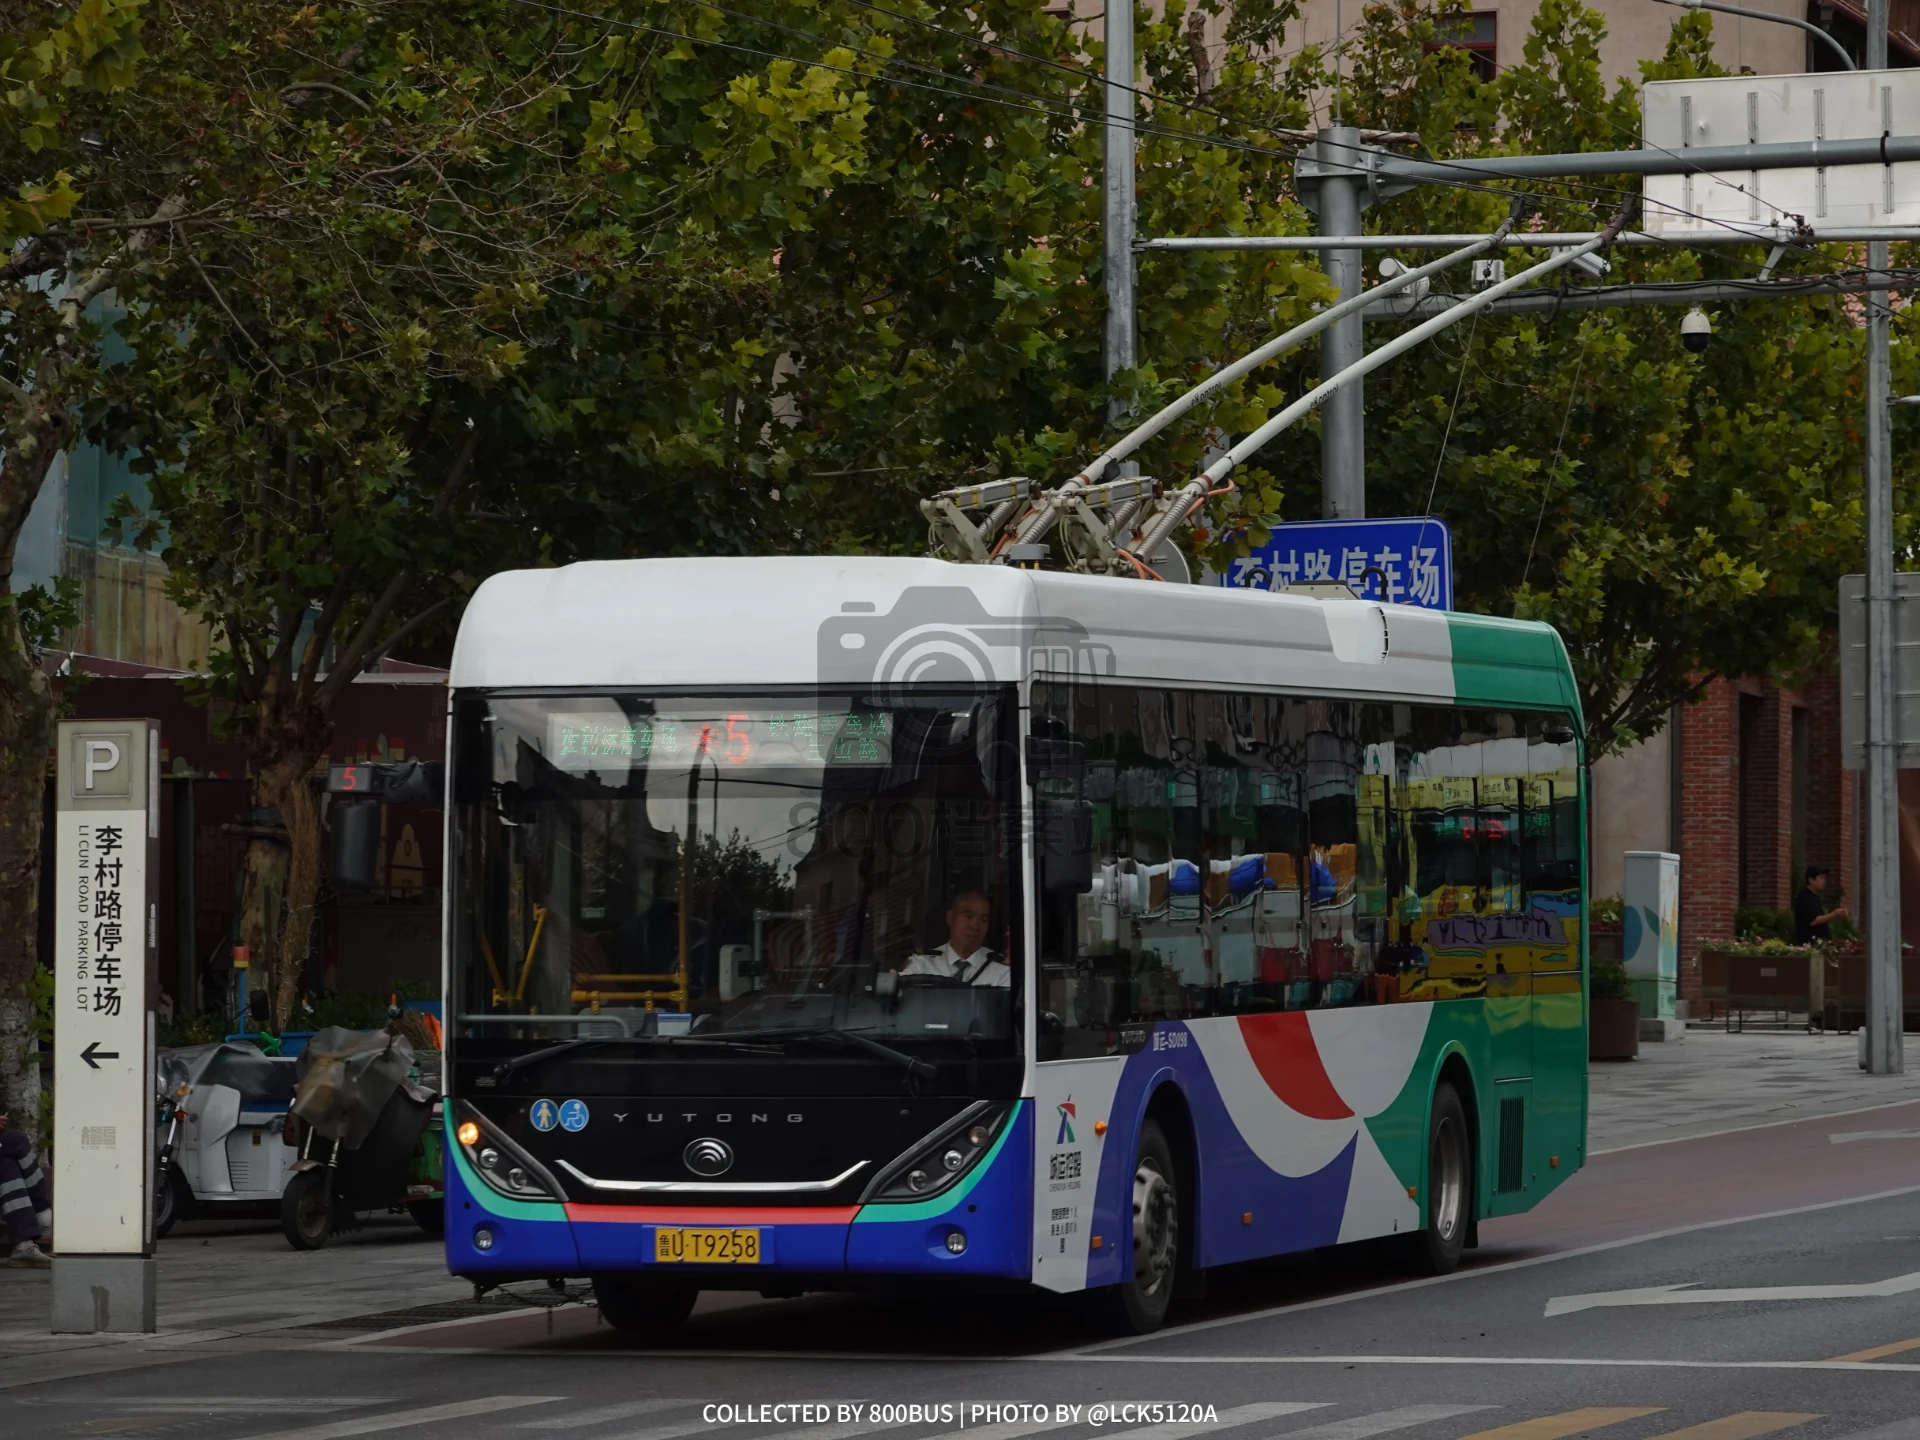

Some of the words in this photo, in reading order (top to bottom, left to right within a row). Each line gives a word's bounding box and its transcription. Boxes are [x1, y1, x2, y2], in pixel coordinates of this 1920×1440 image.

[726, 713, 751, 763] 5
[85, 741, 120, 789] P
[342, 766, 357, 791] 5
[78, 876, 90, 913] ROAD
[93, 825, 123, 1016] 李村路停车场
[77, 921, 89, 980] PARKING
[77, 986, 88, 1012] LOT
[613, 1113, 804, 1123] YUTONG
